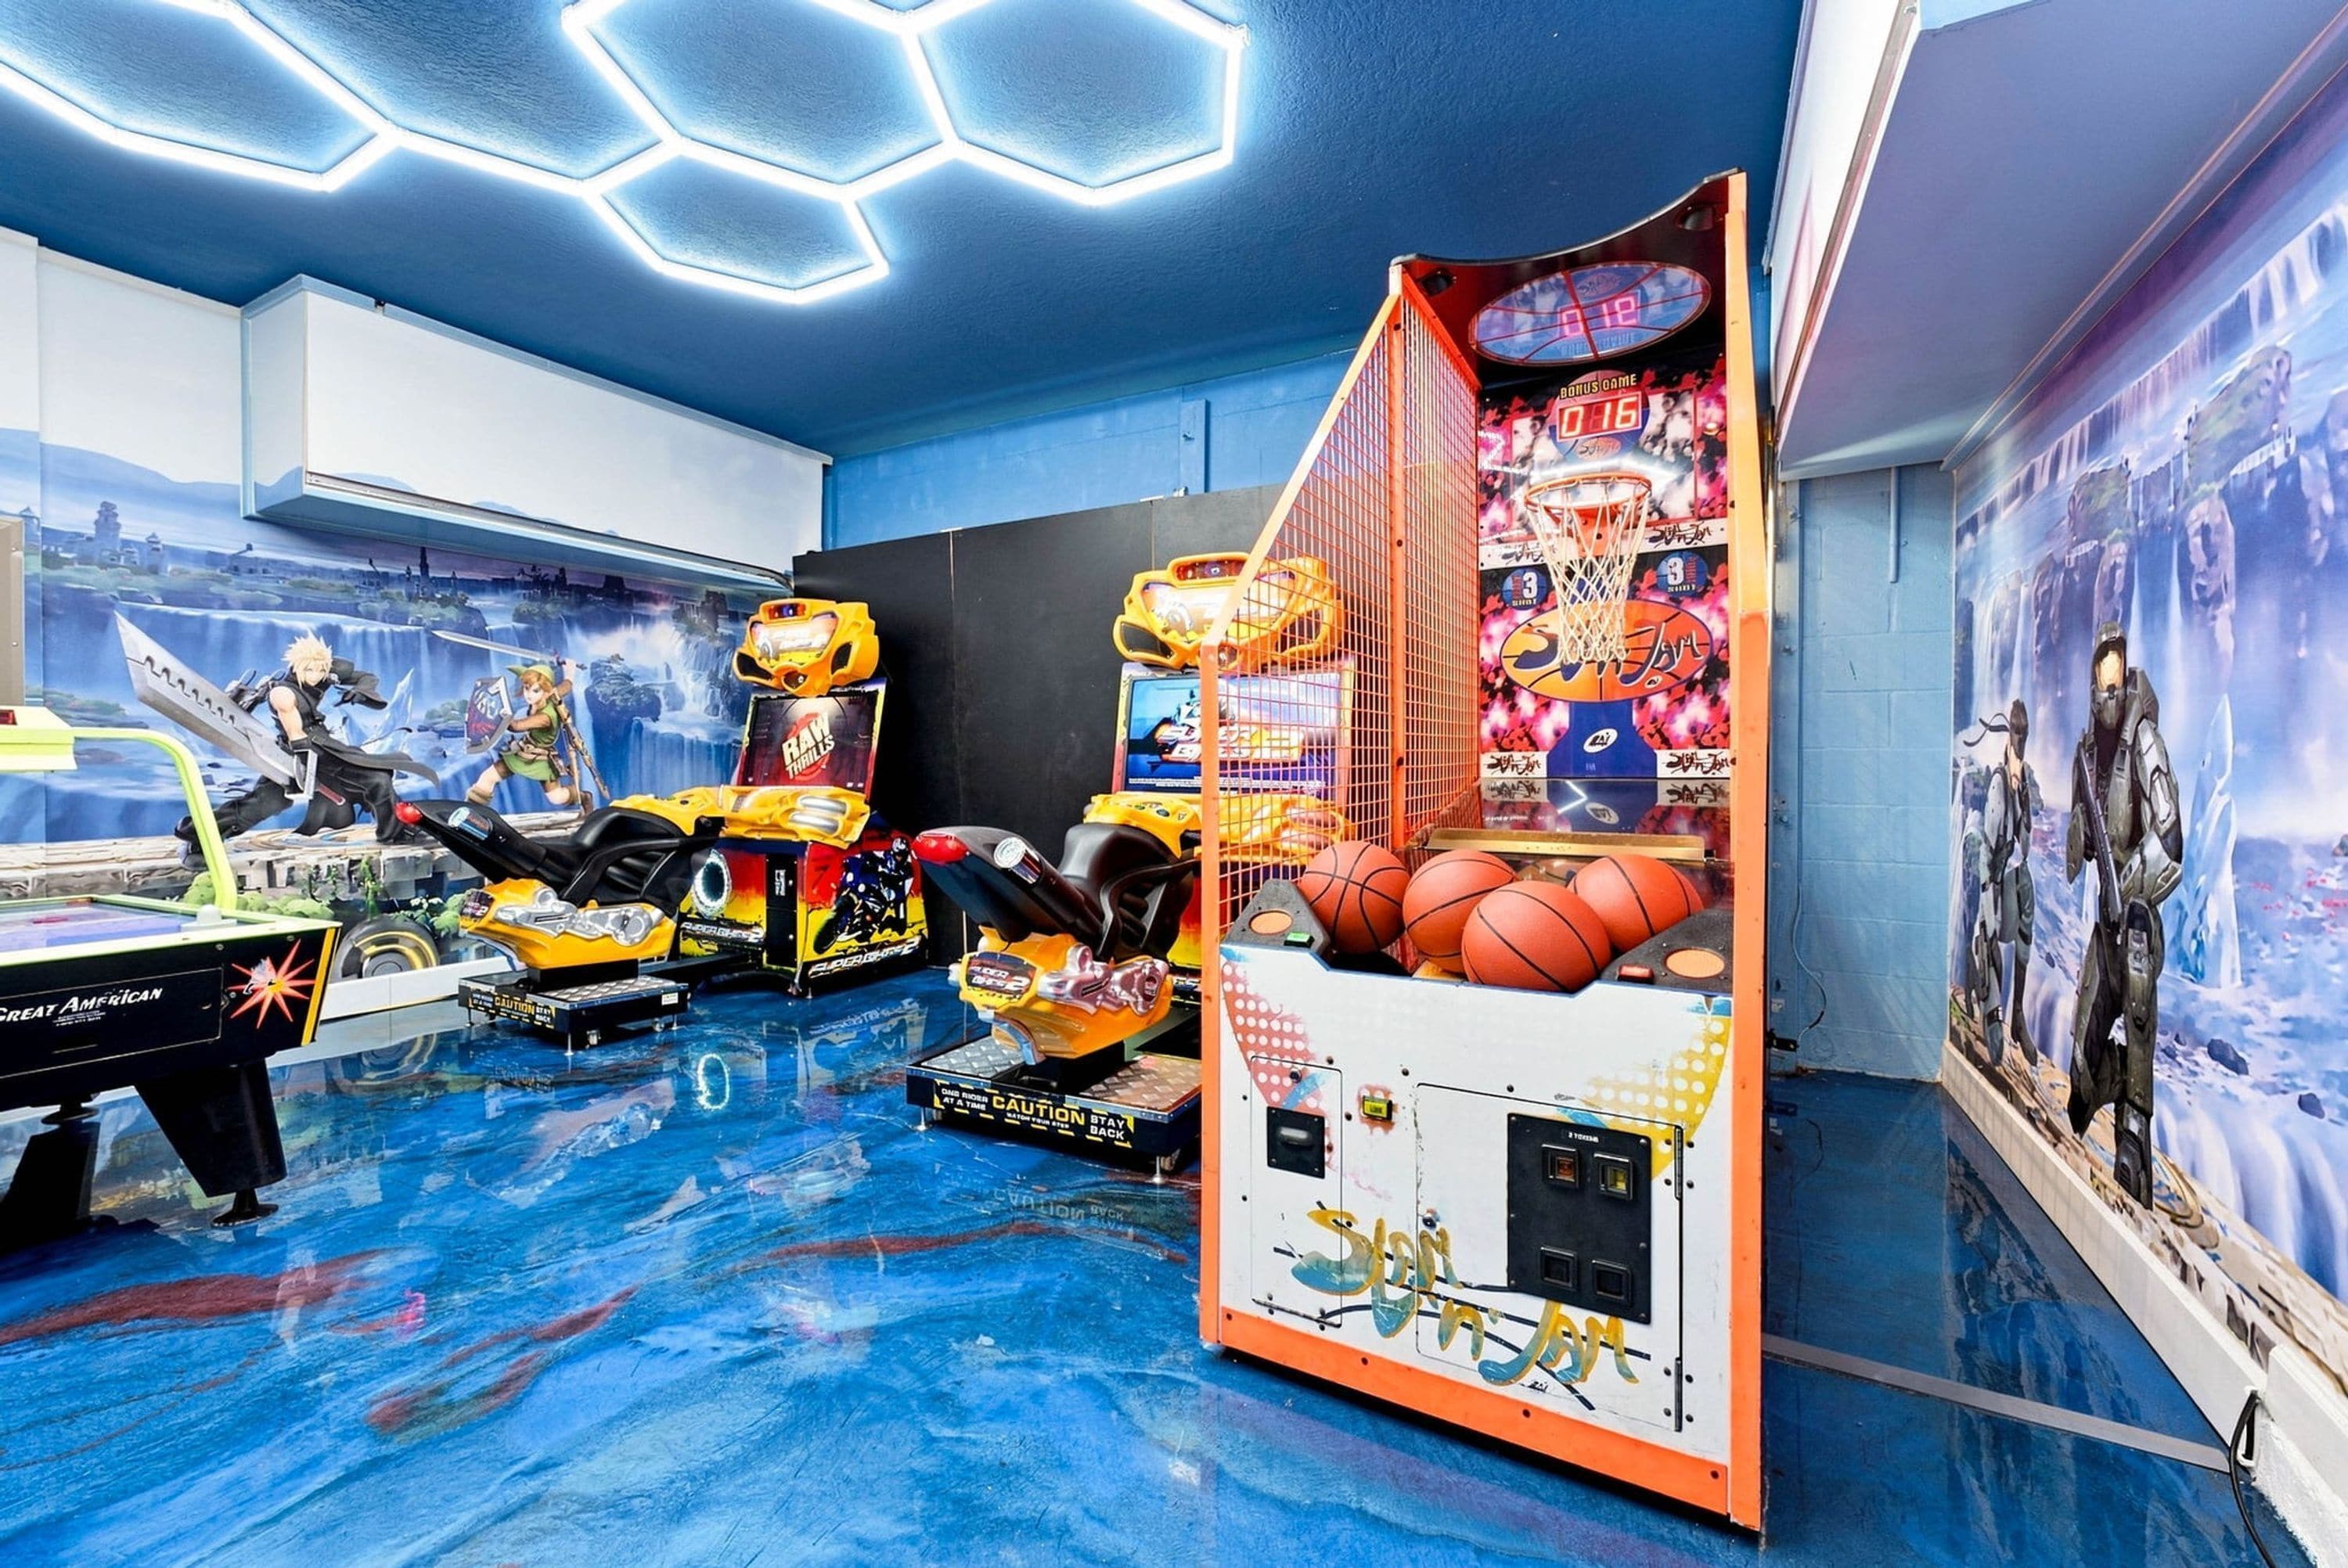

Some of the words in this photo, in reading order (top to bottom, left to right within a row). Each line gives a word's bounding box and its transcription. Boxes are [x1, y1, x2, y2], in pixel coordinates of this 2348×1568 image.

[1561, 381, 1598, 399] BONUS
[1602, 374, 1637, 391] GAME
[1666, 556, 1684, 586] 3
[1522, 571, 1538, 599] 3
[783, 712, 830, 766] RAW
[786, 734, 835, 779] THRILLS
[495, 996, 535, 1016] CAUTION
[942, 1088, 960, 1097] ONE
[962, 1091, 989, 1103] RIDER
[966, 1101, 986, 1110] TIME
[992, 1095, 1085, 1125] CAUTION
[1007, 1112, 1030, 1121] WATCH
[1032, 1117, 1050, 1125] YOUR
[1090, 1114, 1125, 1129] STAY
[1090, 1124, 1124, 1140] BACK
